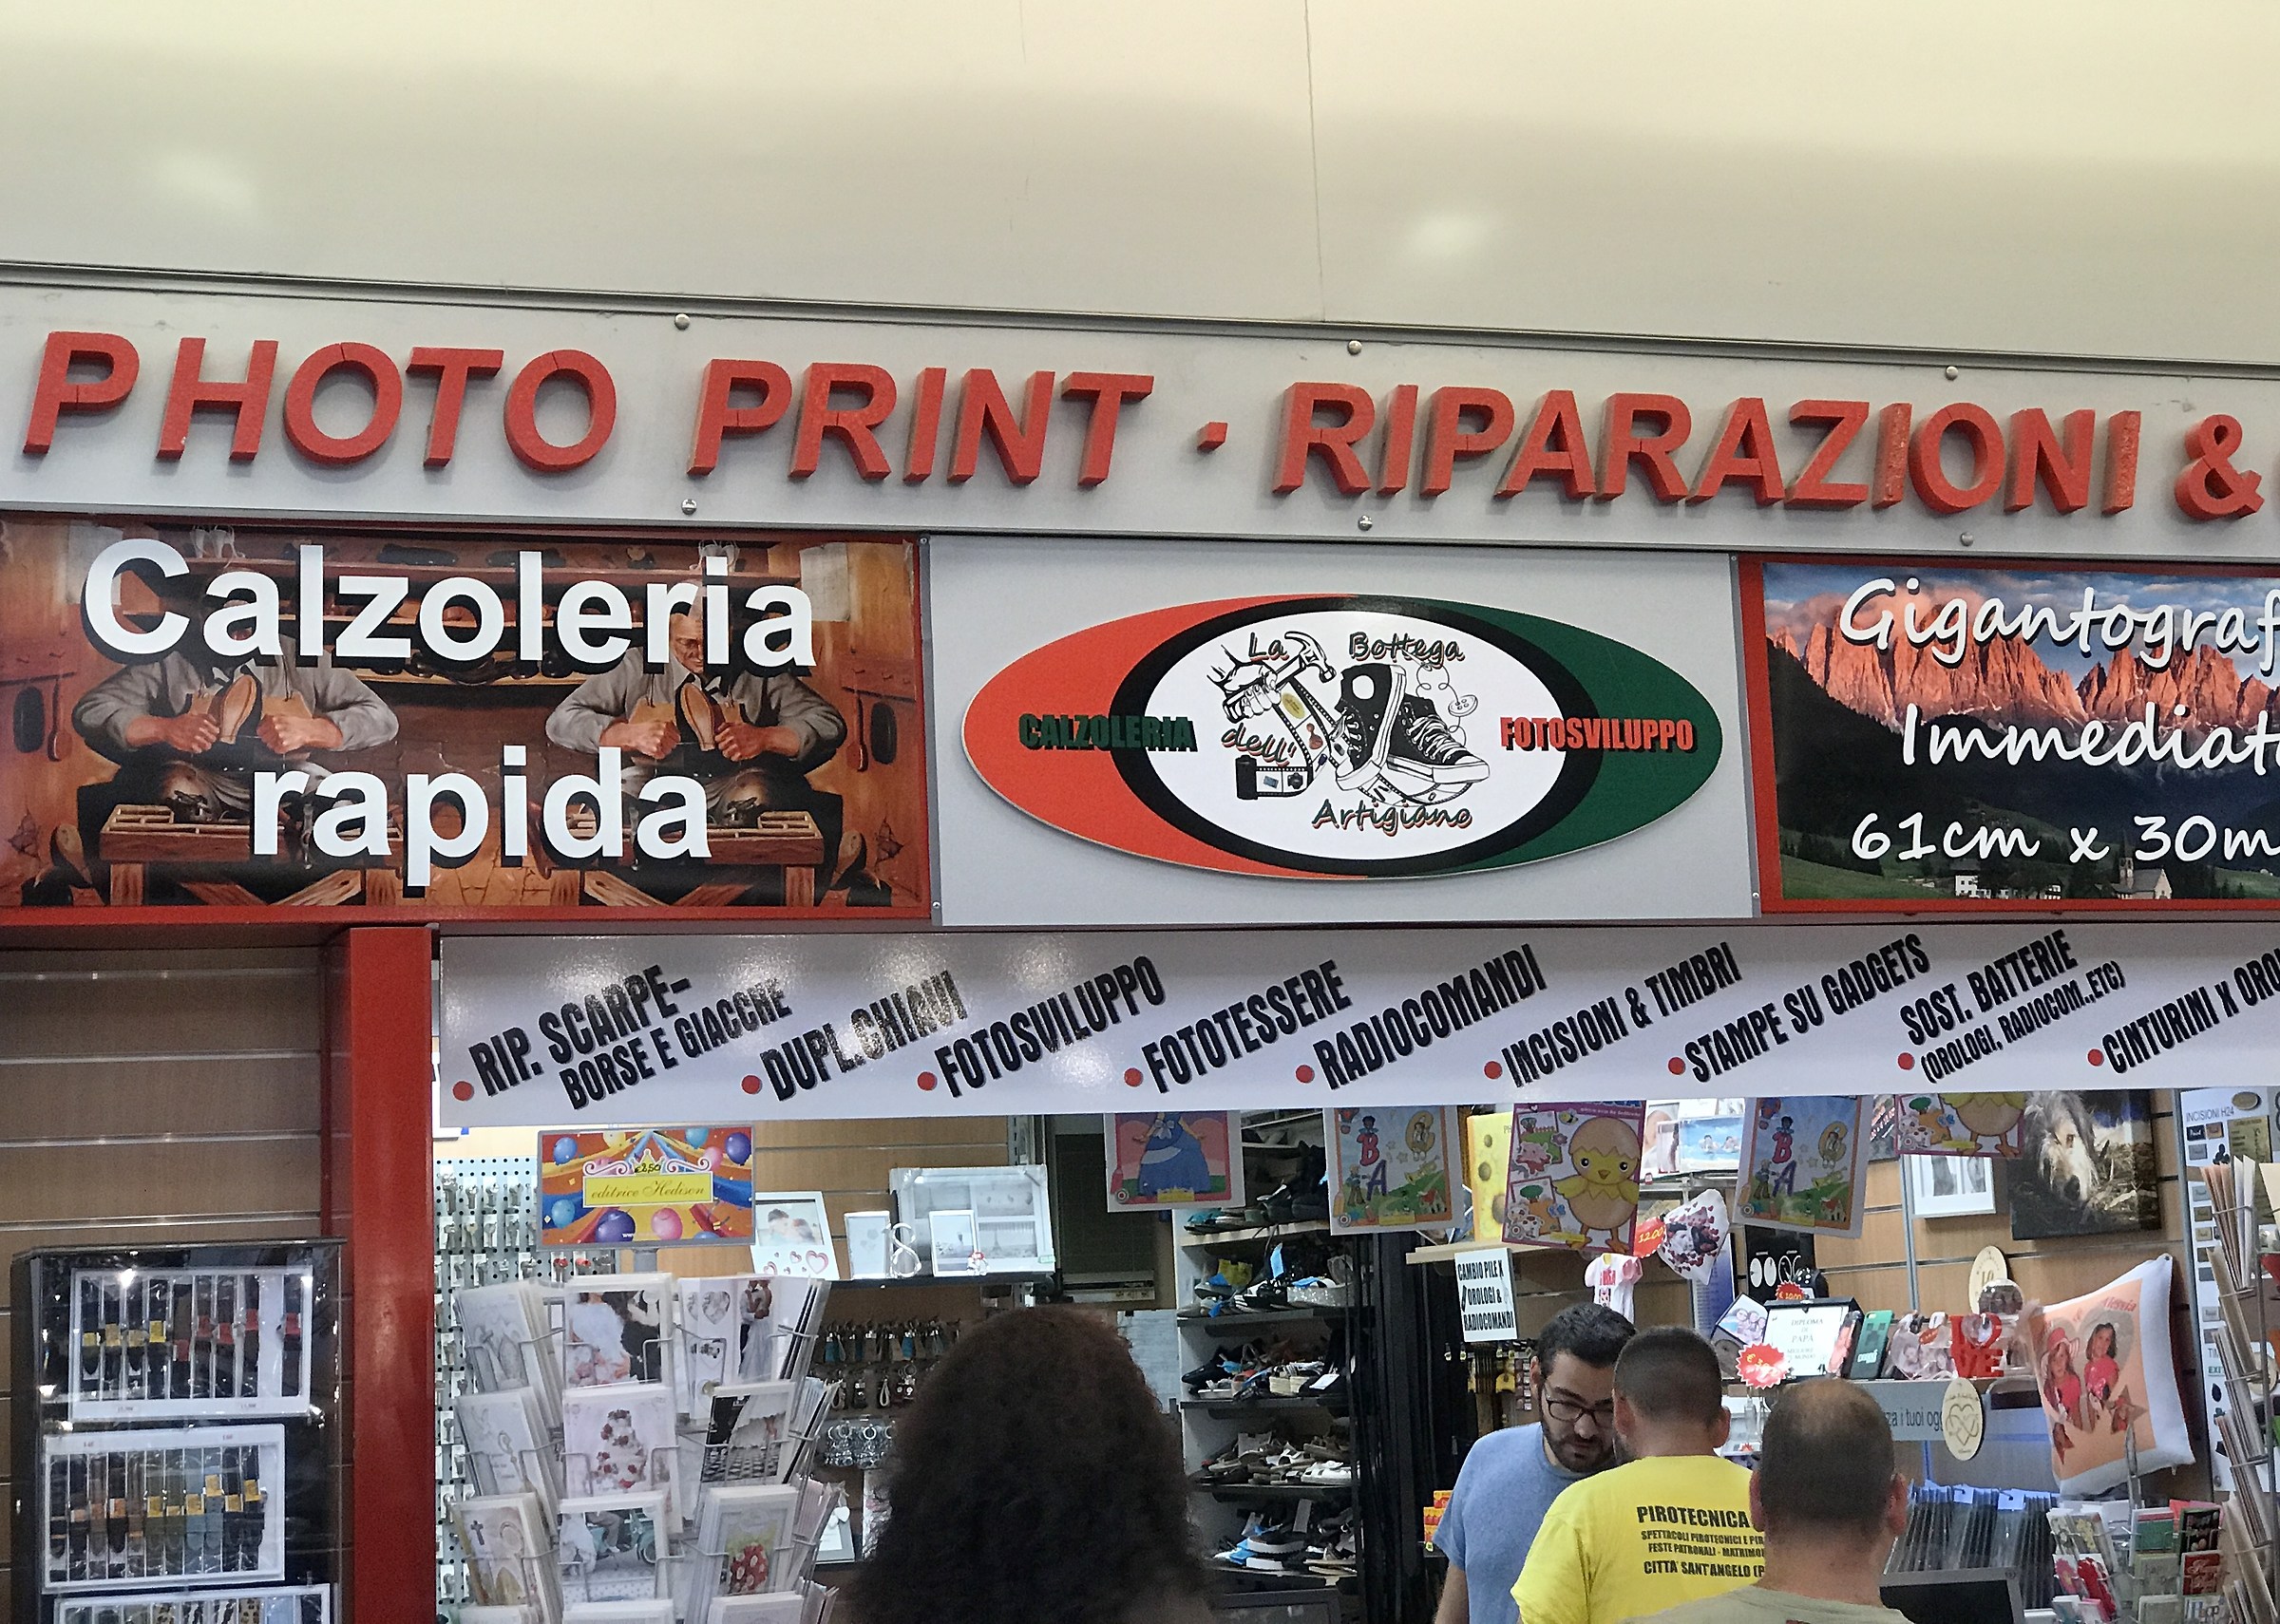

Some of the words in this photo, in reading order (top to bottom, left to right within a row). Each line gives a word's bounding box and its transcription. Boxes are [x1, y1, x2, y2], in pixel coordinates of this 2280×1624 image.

[23, 330, 618, 471] PHOTO
[687, 359, 1154, 486] PRINT
[1273, 382, 2141, 514] RIPARAZIONI
[2175, 414, 2265, 520] &
[82, 538, 817, 670] Calzoleria
[1248, 632, 1289, 662] La
[1349, 631, 1466, 669] Bottega
[1018, 713, 1198, 752] CALZOLERIA
[1500, 715, 1699, 753] FOTOSVILUPPO
[1902, 701, 2280, 777] Immediat
[253, 745, 712, 888] rapida
[1312, 798, 1473, 838] Artigiano
[1852, 812, 2041, 860] 61cm
[2068, 832, 2109, 862] x
[1684, 1002, 1790, 1084] STAMPE
[1782, 984, 1825, 1034] SU
[1820, 933, 1931, 1016] GADGETS
[1900, 983, 1974, 1046] SOST.
[1966, 929, 2079, 1013] BATTERIE
[934, 955, 1167, 1099] FOTOSVILUPPO
[1141, 959, 1353, 1094] FOTOTESSERE
[1313, 943, 1548, 1090] RADIOCOMANDI
[1501, 995, 1630, 1088] INCISIONI
[1624, 987, 1653, 1029] &
[1644, 941, 1743, 1018] TIMBRI
[2101, 986, 2220, 1074] CINTURINI
[468, 1027, 544, 1097] RIP.
[559, 1037, 656, 1110] BORSE
[650, 1027, 679, 1069] E
[2186, 1108, 2220, 1122] INCISIONI
[591, 1185, 640, 1199] editrice
[643, 1180, 705, 1197] Hedison
[1457, 1261, 1483, 1281] CAMBIO
[1483, 1260, 1498, 1278] PILE
[1463, 1311, 1514, 1331] RADIOCOMANDI
[1468, 1286, 1495, 1306] OROLOGI
[1906, 1407, 1924, 1426] tuoi
[1637, 1505, 1750, 1528] PIROTECNICA
[1641, 1529, 1689, 1542] SPETTACOLI
[1691, 1532, 1741, 1545] PIROTECNICI
[1648, 1542, 1673, 1553] FESTE
[1674, 1543, 1716, 1557] PATRONALI
